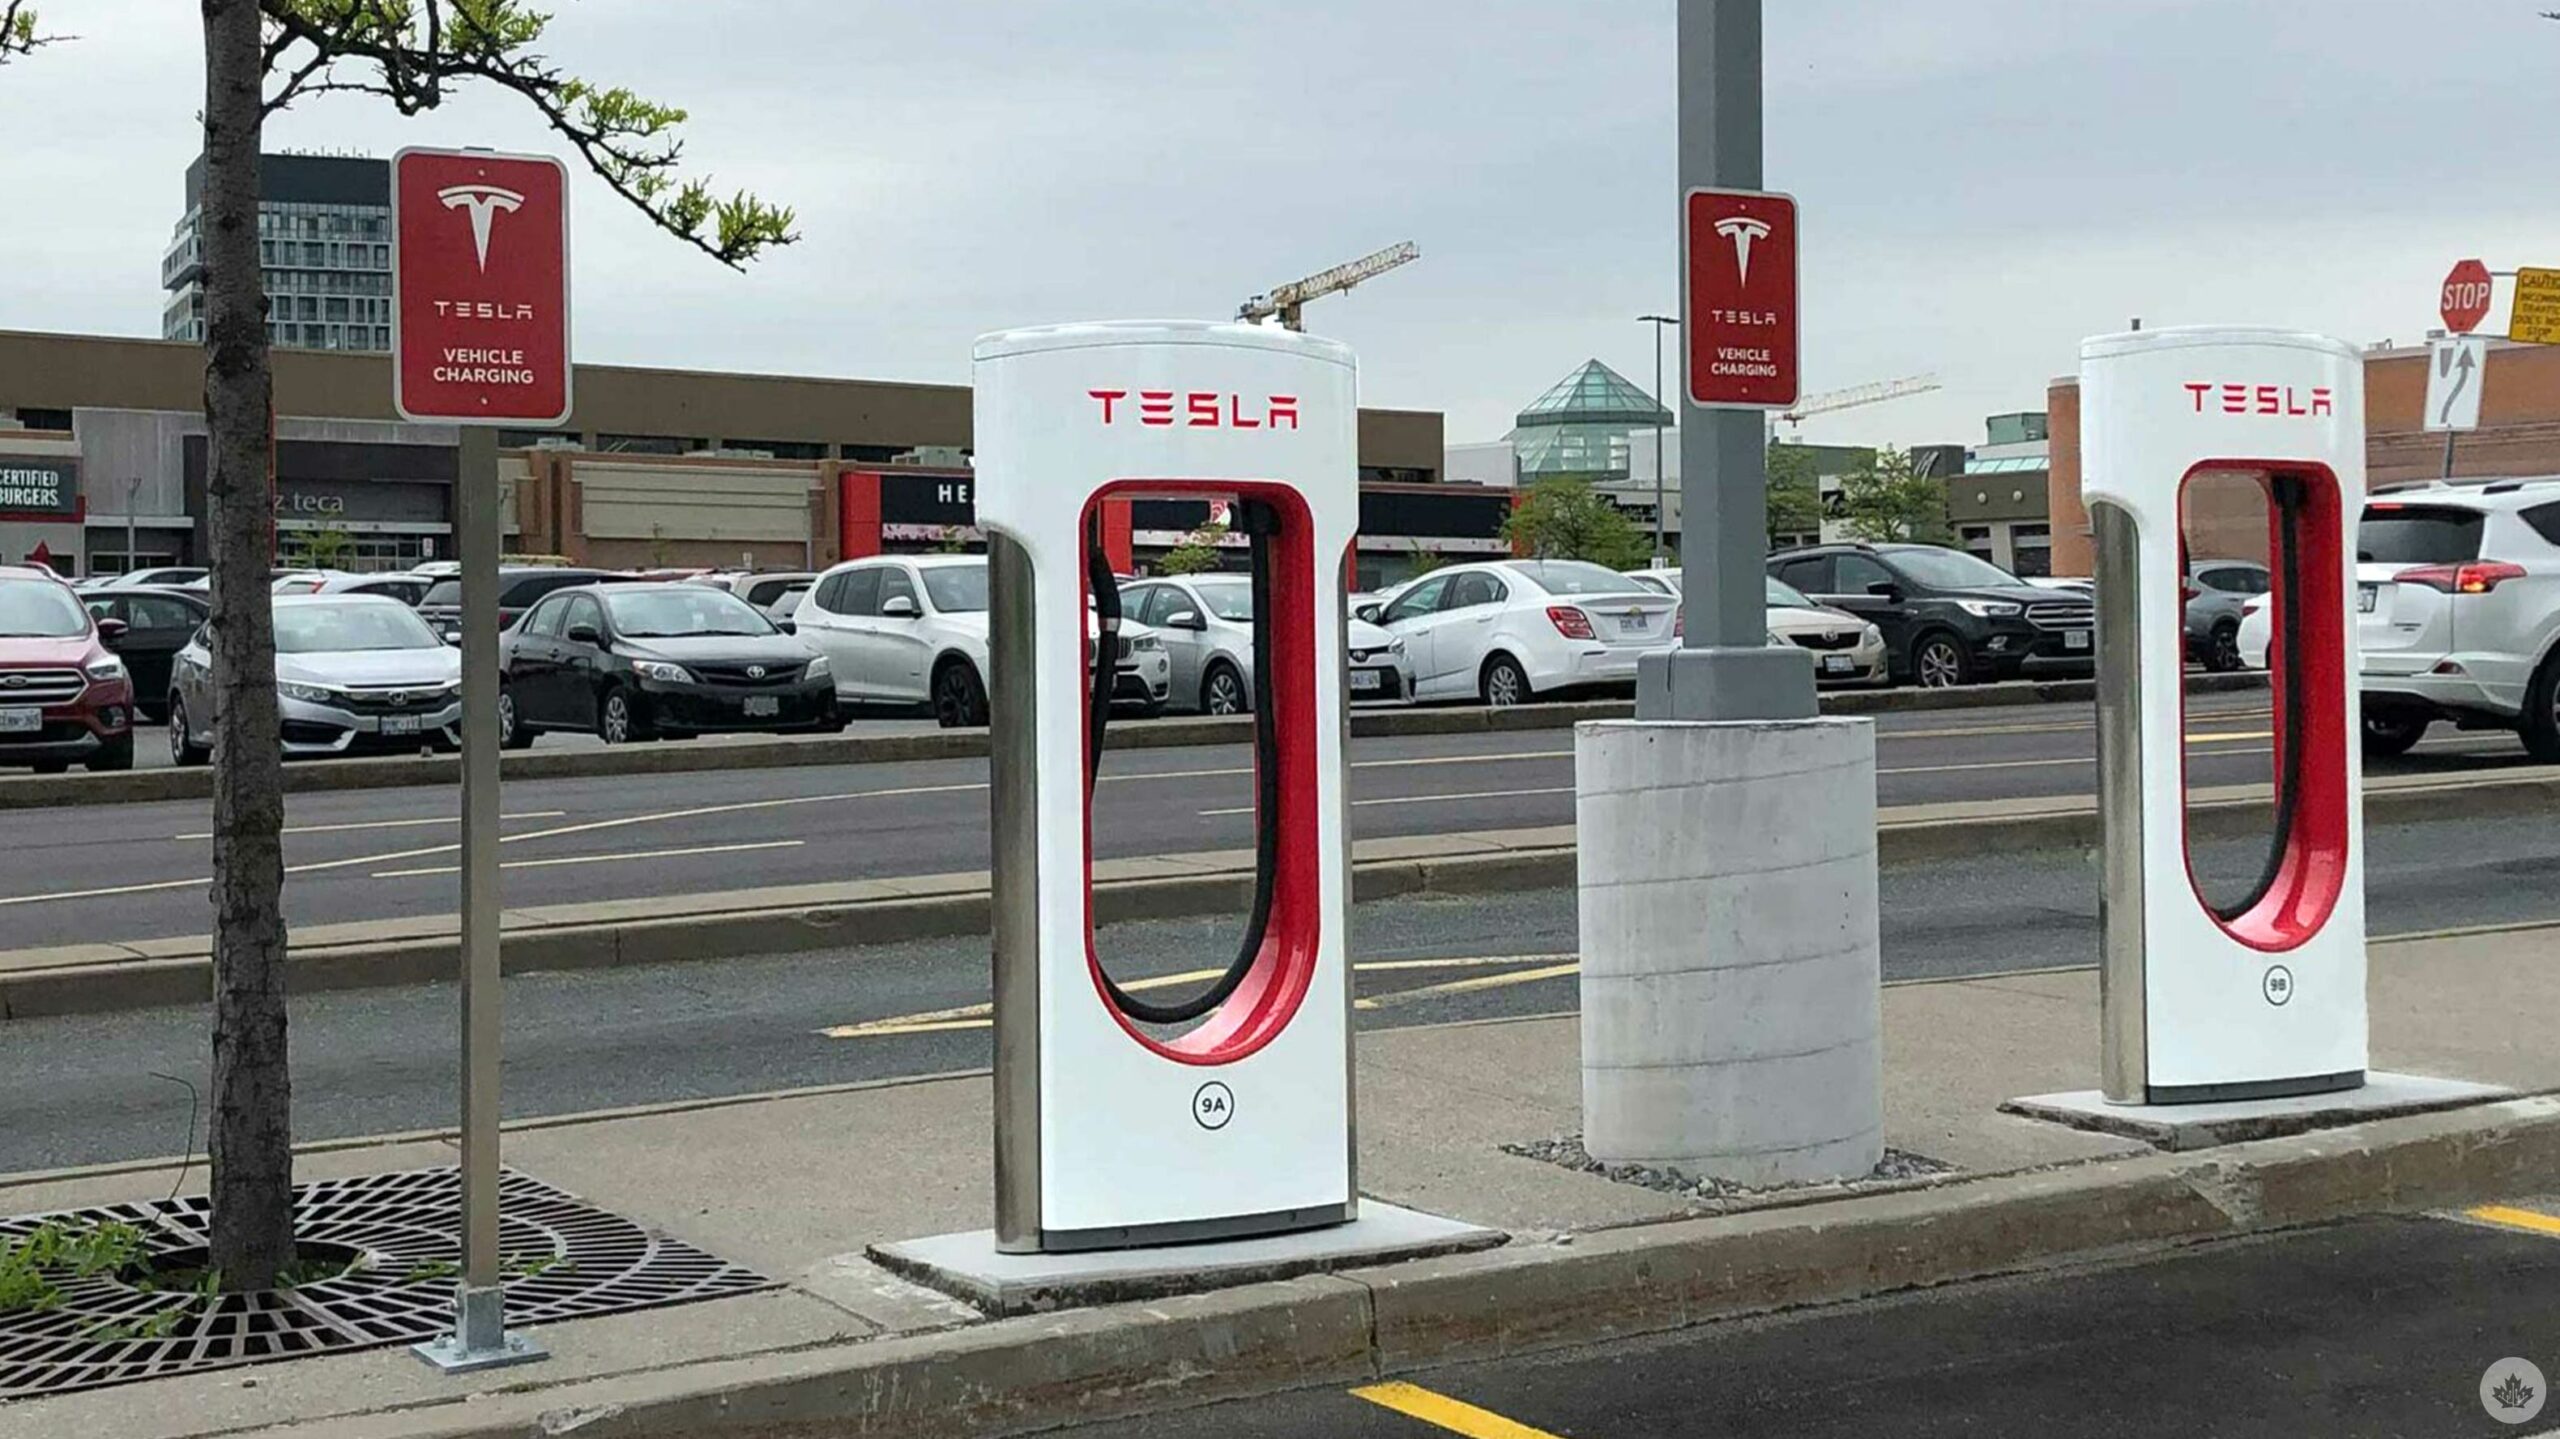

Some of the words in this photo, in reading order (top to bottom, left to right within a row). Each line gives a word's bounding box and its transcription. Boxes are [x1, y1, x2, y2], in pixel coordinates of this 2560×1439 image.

[2443, 283, 2490, 311] STOP
[433, 301, 533, 320] TESLA
[1711, 310, 1777, 325] TESLA
[443, 348, 524, 365] VEHICLE
[1717, 347, 1771, 362] VEHICLE
[433, 366, 534, 385] CHARGING
[1710, 362, 1777, 377] CHARGING
[1088, 390, 1297, 429] TESLA
[2184, 384, 2331, 417] TESLA
[293, 491, 345, 513] teca
[938, 484, 976, 503] HE
[2270, 978, 2287, 991] 9B
[1202, 1097, 1226, 1113] 9A
